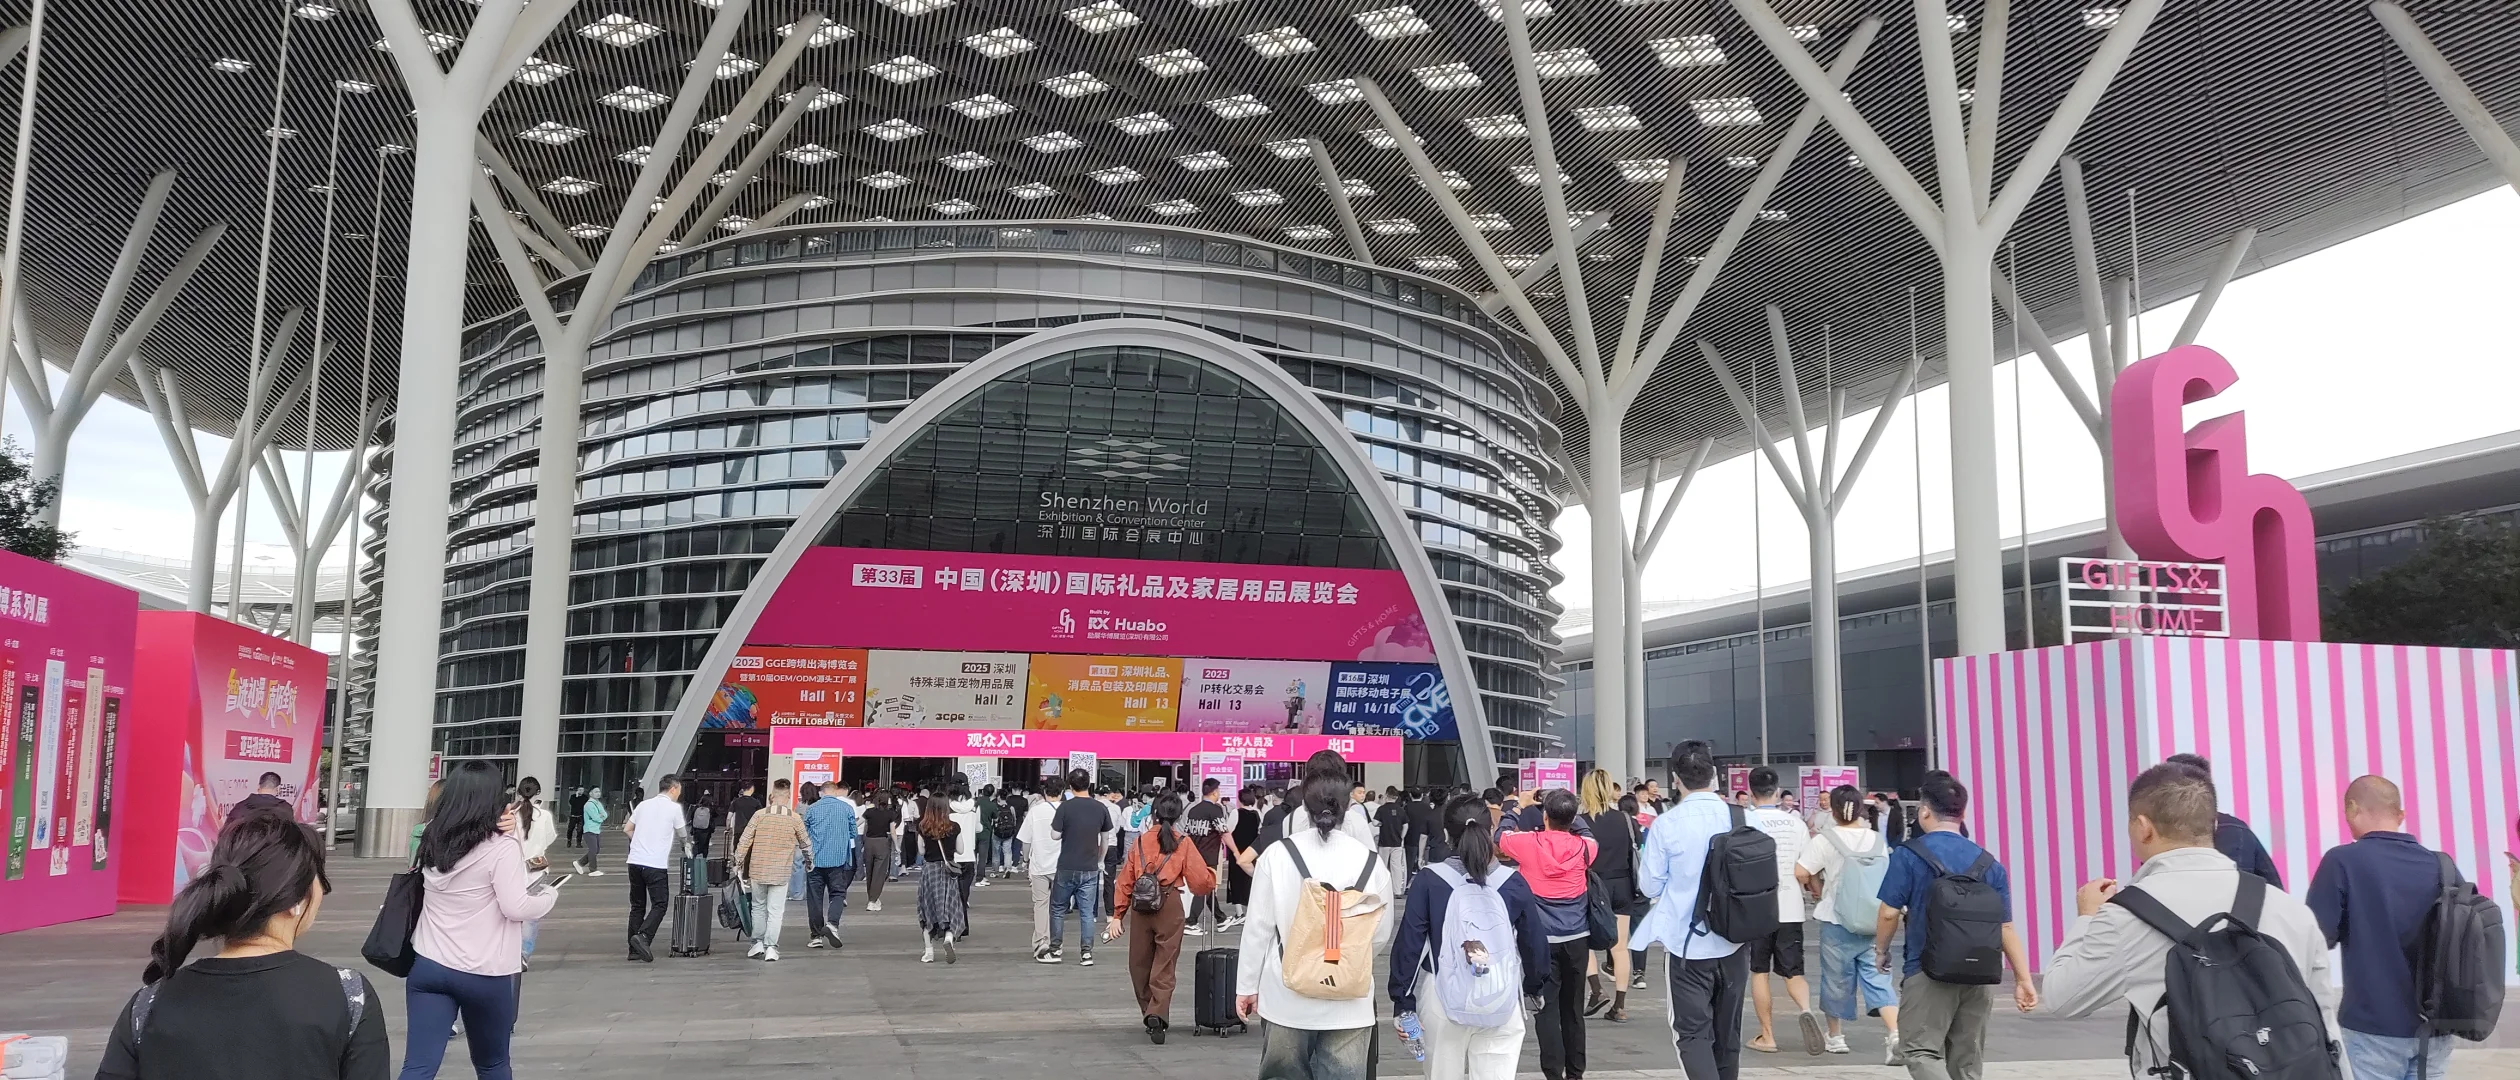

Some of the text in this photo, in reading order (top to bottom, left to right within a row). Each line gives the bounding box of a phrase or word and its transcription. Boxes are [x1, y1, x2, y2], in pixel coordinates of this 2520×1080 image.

[1039, 491, 1208, 516] Shenzhen World
[1038, 510, 1206, 528] Exhibition & Convention Center
[1037, 524, 1204, 545] 深圳国际会展中心
[860, 566, 1359, 605] 第33届 中国（深圳）国际礼品及家居用品展览会
[1087, 616, 1167, 632] RX Huabo
[1347, 625, 1368, 647] GIFTS
[1374, 604, 1399, 627] HOME
[2110, 604, 2204, 636] HOME
[736, 658, 858, 670] 2025 GGE跨境出海博览会
[964, 663, 1017, 675] 2025 深圳
[1205, 670, 1228, 679] 2025
[1367, 673, 1390, 685] 深圳
[909, 676, 1015, 690] 特殊渠道宠物用品展
[1067, 679, 1169, 693] 消费品包装及印刷展
[1200, 683, 1265, 696] IP转化交易会
[800, 689, 855, 703] Hall 1/3
[1335, 686, 1412, 699] 国际移动电子展
[974, 693, 1014, 706] Hall 2
[1124, 696, 1169, 709] Hall 13
[1198, 698, 1242, 711] Hall 13
[1333, 701, 1397, 715] Hall 14/16
[770, 717, 846, 726] SOUTH LOBBY(E)
[1331, 720, 1354, 731] CME
[967, 733, 1026, 749] 观众入口
[1222, 736, 1274, 748] 工作人员及
[1327, 737, 1355, 753] 出口
[979, 748, 1009, 756] Entrance
[804, 763, 830, 771] 观众登记
[1209, 766, 1234, 774] 观众登记
